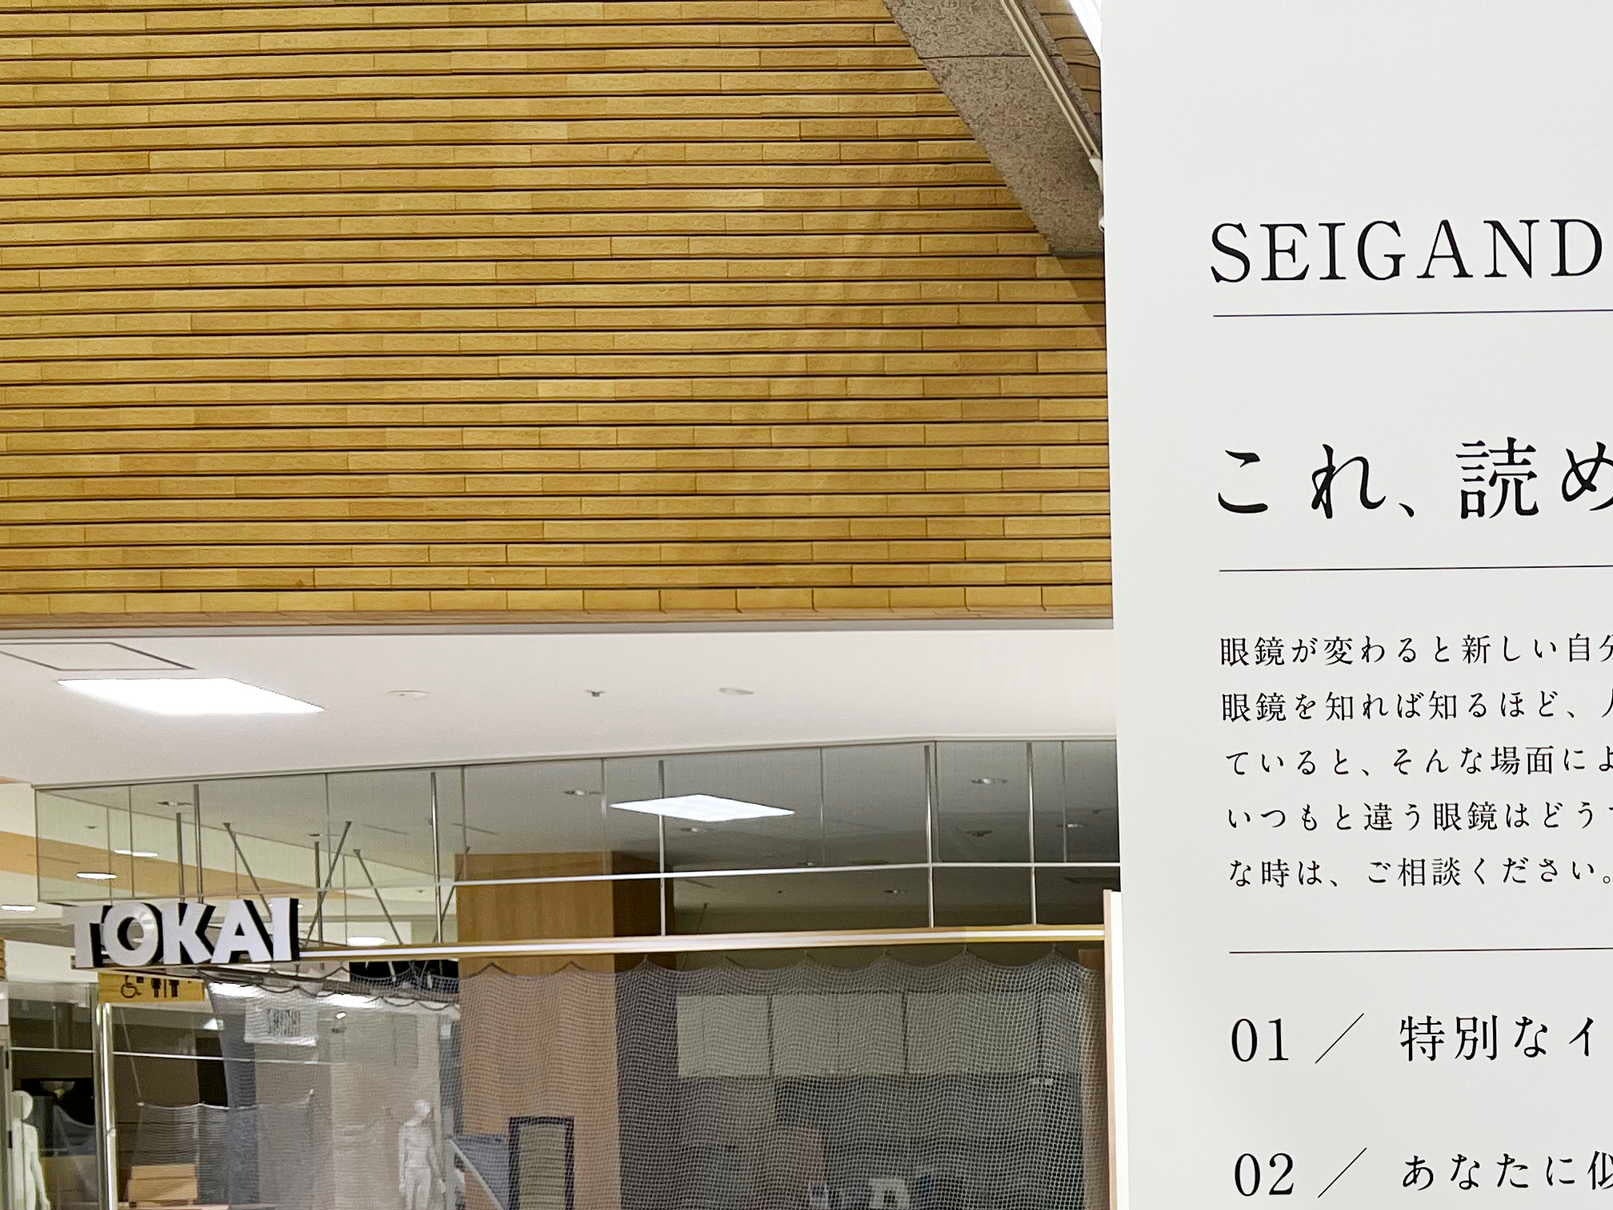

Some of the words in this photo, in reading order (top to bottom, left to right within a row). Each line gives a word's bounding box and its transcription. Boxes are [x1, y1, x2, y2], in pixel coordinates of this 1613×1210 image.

[66, 897, 299, 969] TOKAI
[1231, 1017, 1289, 1063] 01
[1234, 1152, 1295, 1198] 02
